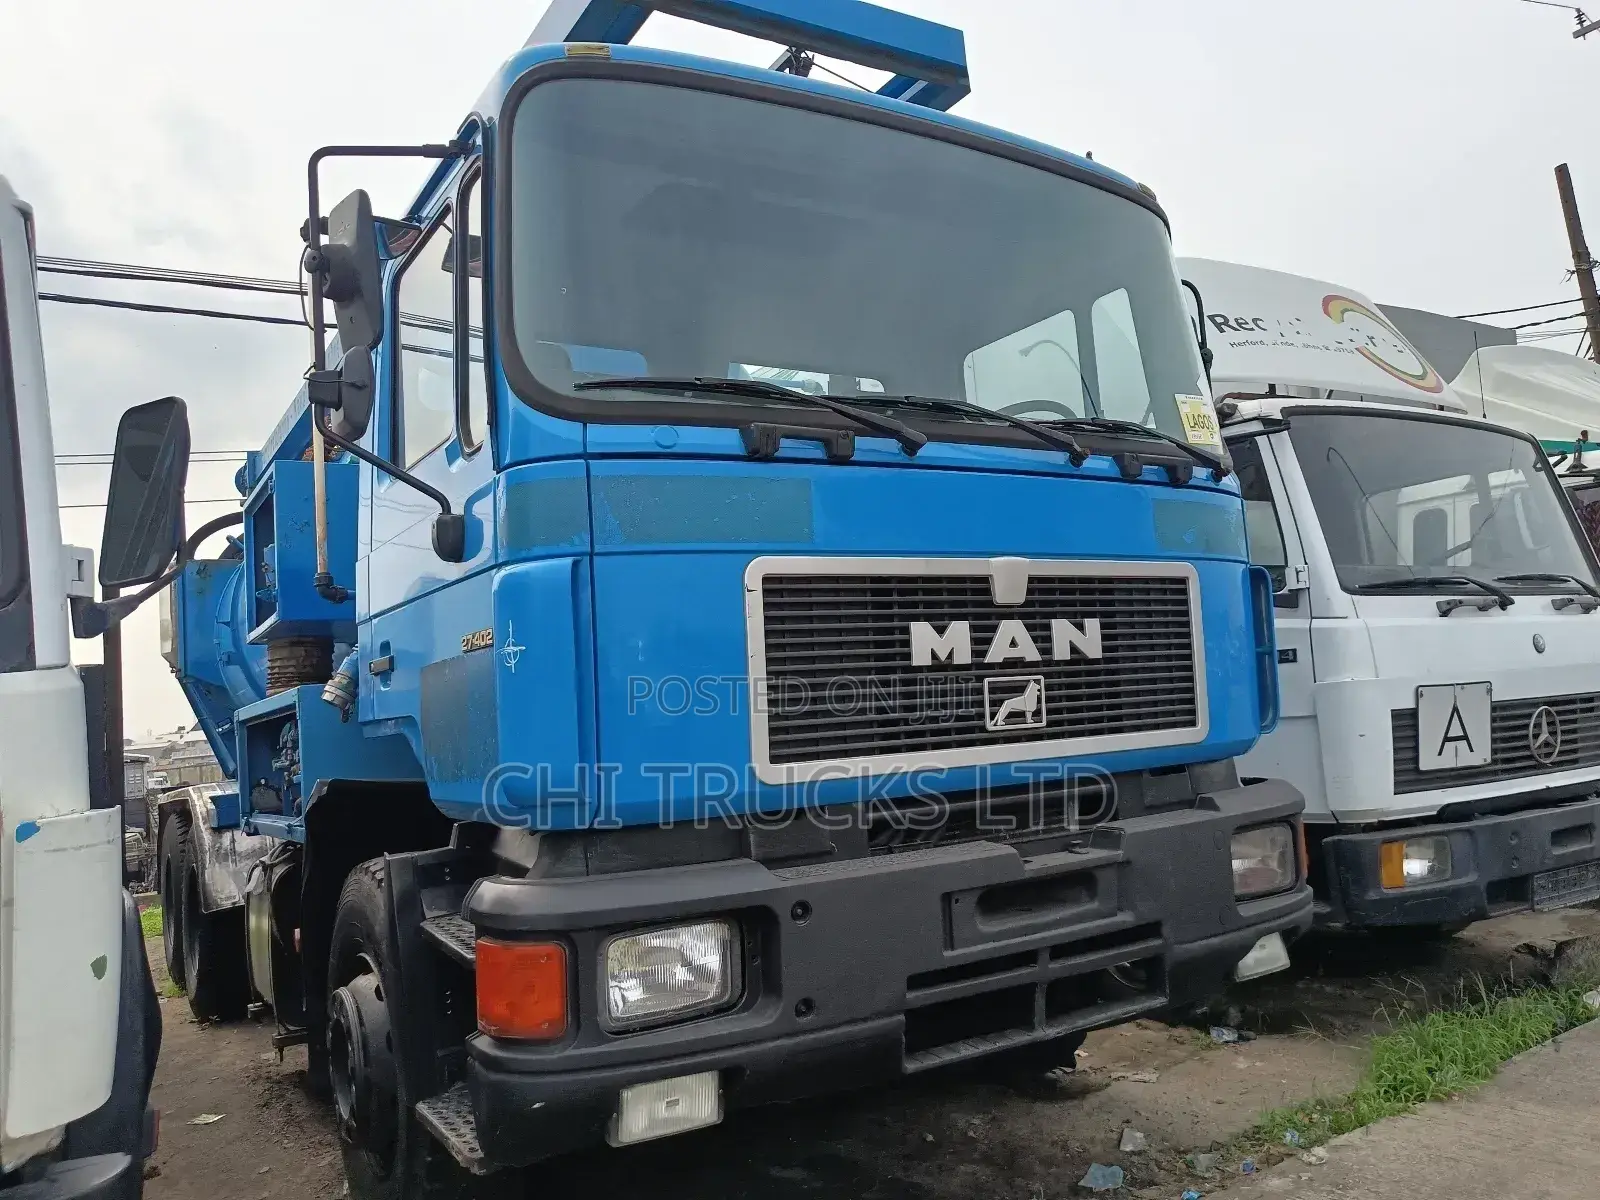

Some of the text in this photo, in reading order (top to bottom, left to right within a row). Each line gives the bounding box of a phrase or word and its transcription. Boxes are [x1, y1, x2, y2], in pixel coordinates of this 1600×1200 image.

[1185, 413, 1215, 431] LAGOS
[910, 618, 1103, 666] MAN
[1437, 699, 1475, 756] A
